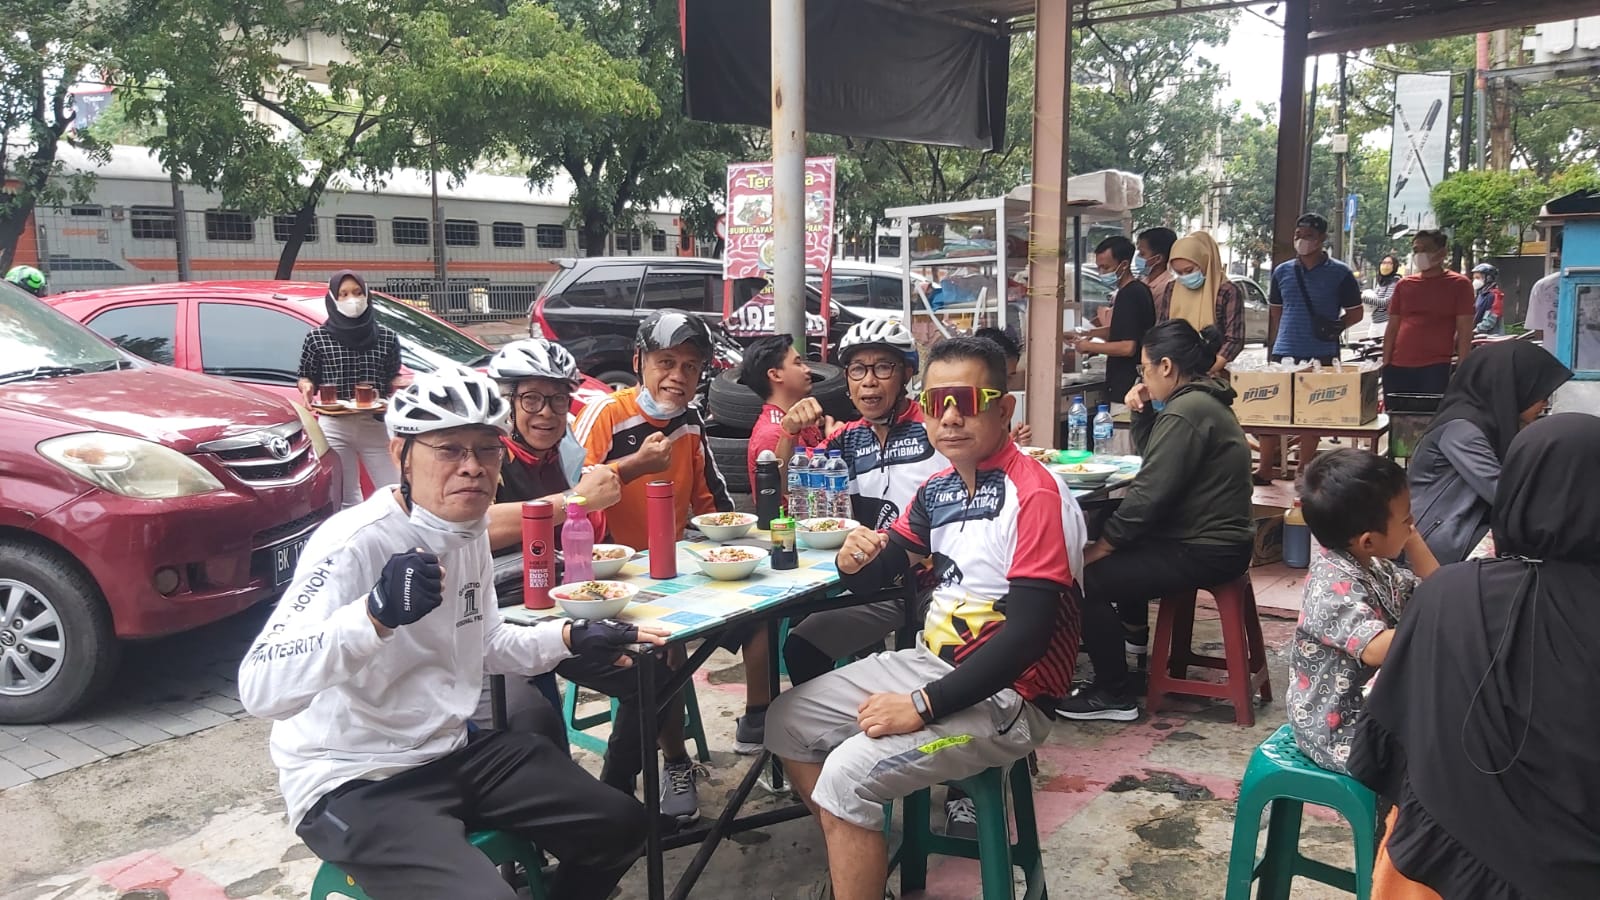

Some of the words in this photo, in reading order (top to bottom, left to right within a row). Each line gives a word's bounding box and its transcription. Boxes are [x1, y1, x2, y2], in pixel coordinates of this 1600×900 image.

[892, 438, 918, 448] JAGA
[278, 548, 290, 571] BK
[290, 567, 331, 613] HONOR
